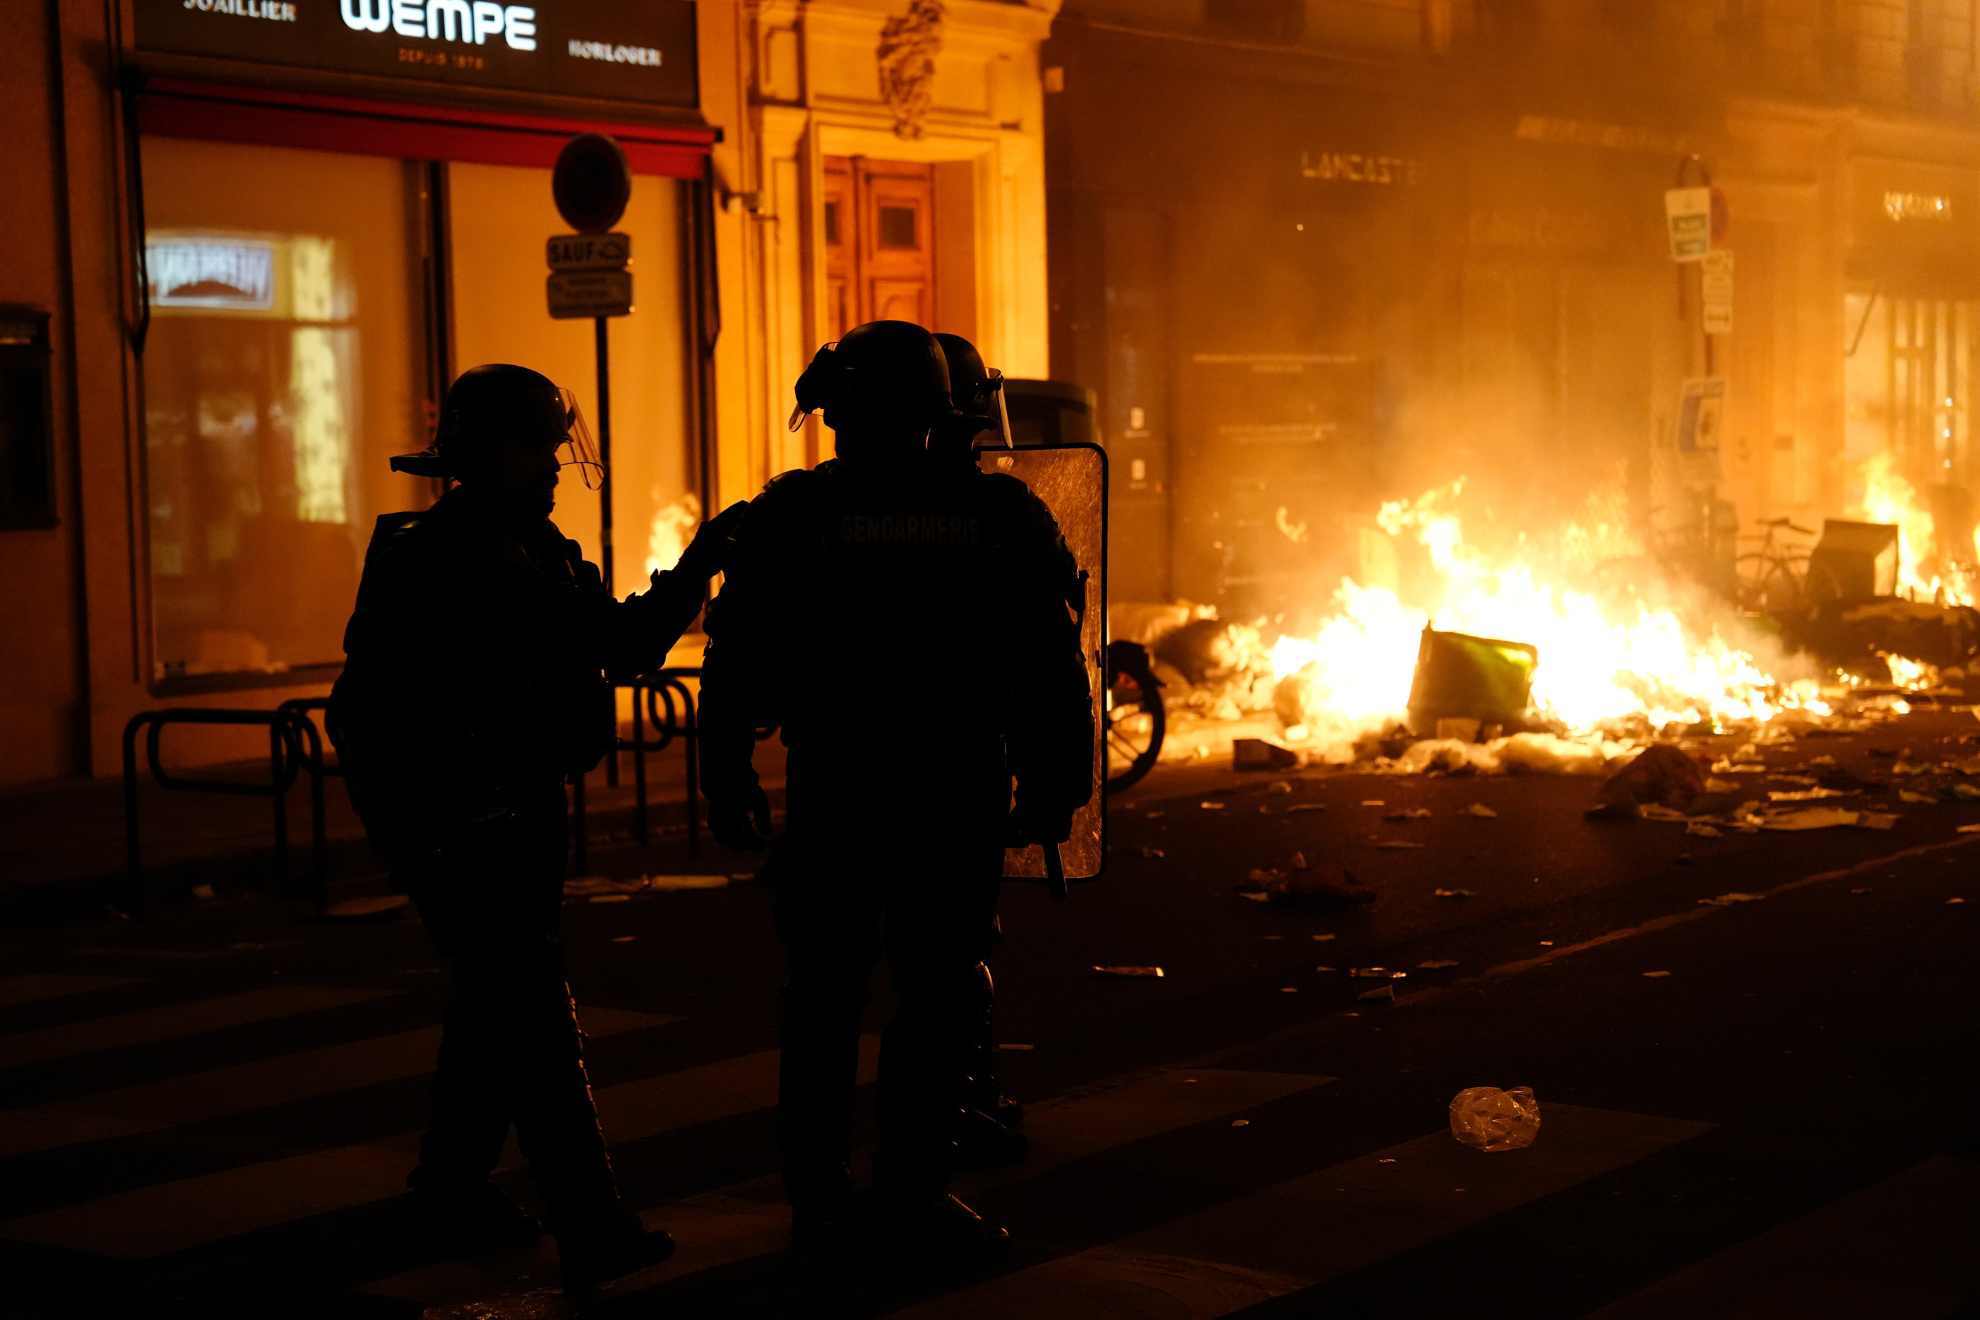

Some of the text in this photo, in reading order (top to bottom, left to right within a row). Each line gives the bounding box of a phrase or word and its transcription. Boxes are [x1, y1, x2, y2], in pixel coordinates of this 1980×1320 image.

[340, 0, 537, 51] WEMPE
[567, 38, 663, 67] HORLOGER
[550, 240, 595, 263] SAUF
[840, 511, 979, 545] GENDARMERIE
